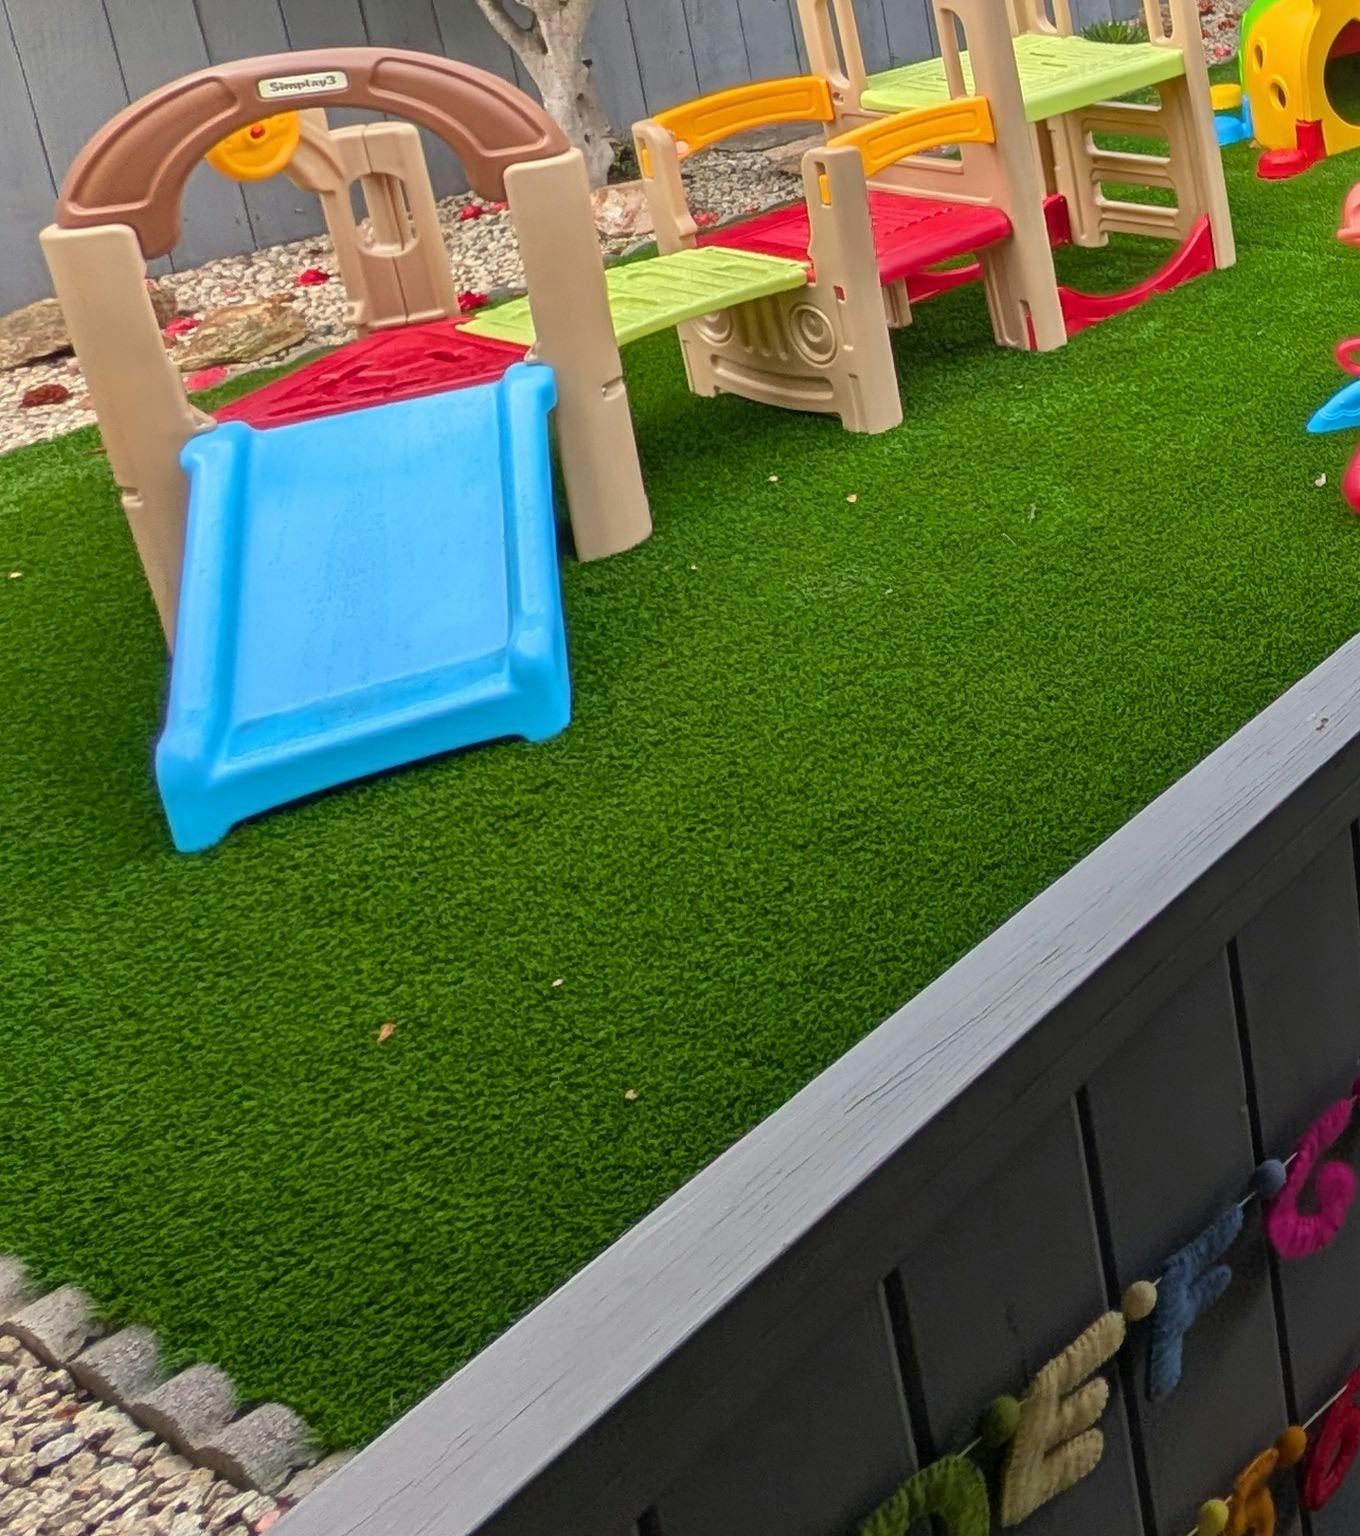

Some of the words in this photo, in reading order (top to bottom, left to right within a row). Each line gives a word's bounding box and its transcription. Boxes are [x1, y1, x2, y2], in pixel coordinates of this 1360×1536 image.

[269, 75, 337, 93] Simplay3
[1001, 1310, 1126, 1528] E
[1149, 1203, 1243, 1402] F
[1267, 1098, 1357, 1259] G
